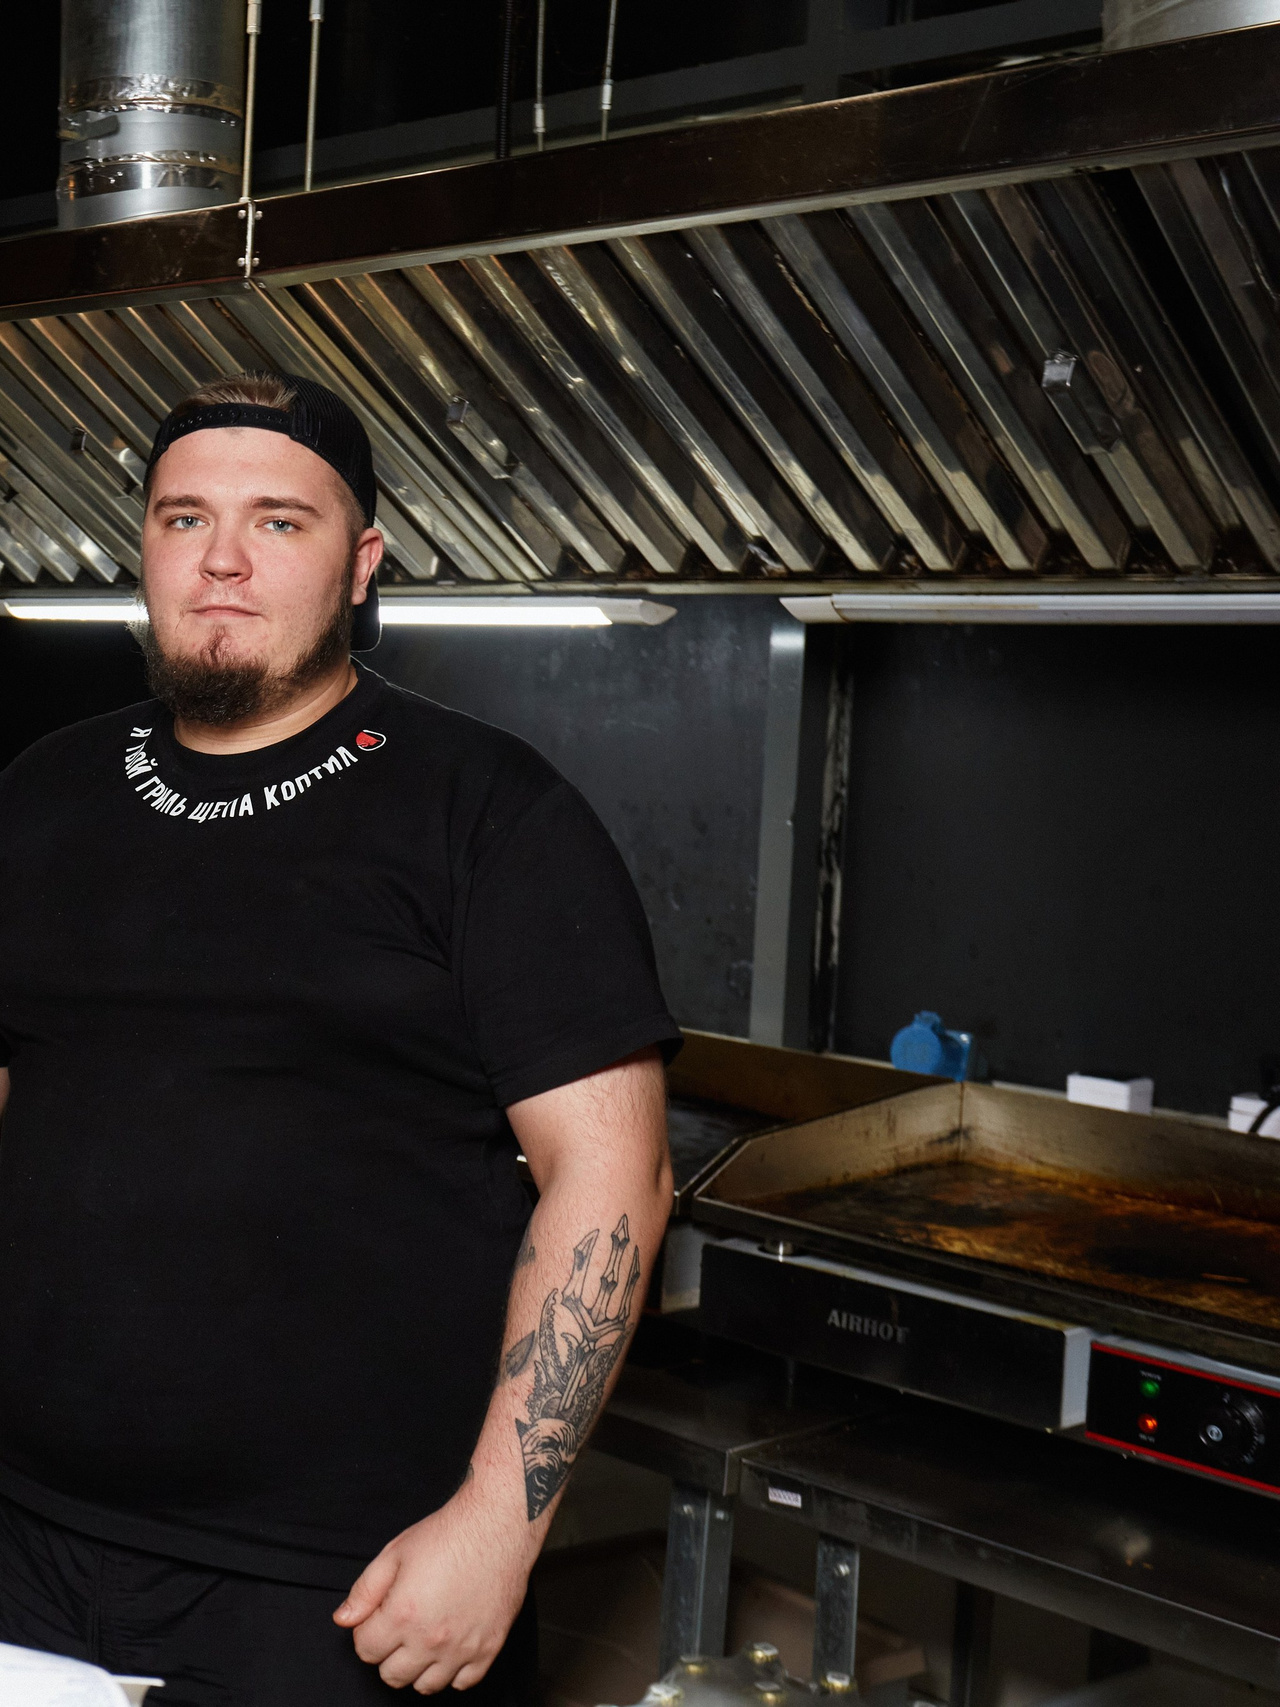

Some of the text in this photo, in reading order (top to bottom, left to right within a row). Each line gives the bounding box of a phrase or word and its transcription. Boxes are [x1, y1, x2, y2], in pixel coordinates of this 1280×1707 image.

[134, 775, 188, 817] ГРИЛЬ
[187, 793, 254, 824] ЩЕПА
[263, 745, 359, 811] КОПТИЛ
[827, 1308, 910, 1344] AIRHOT
